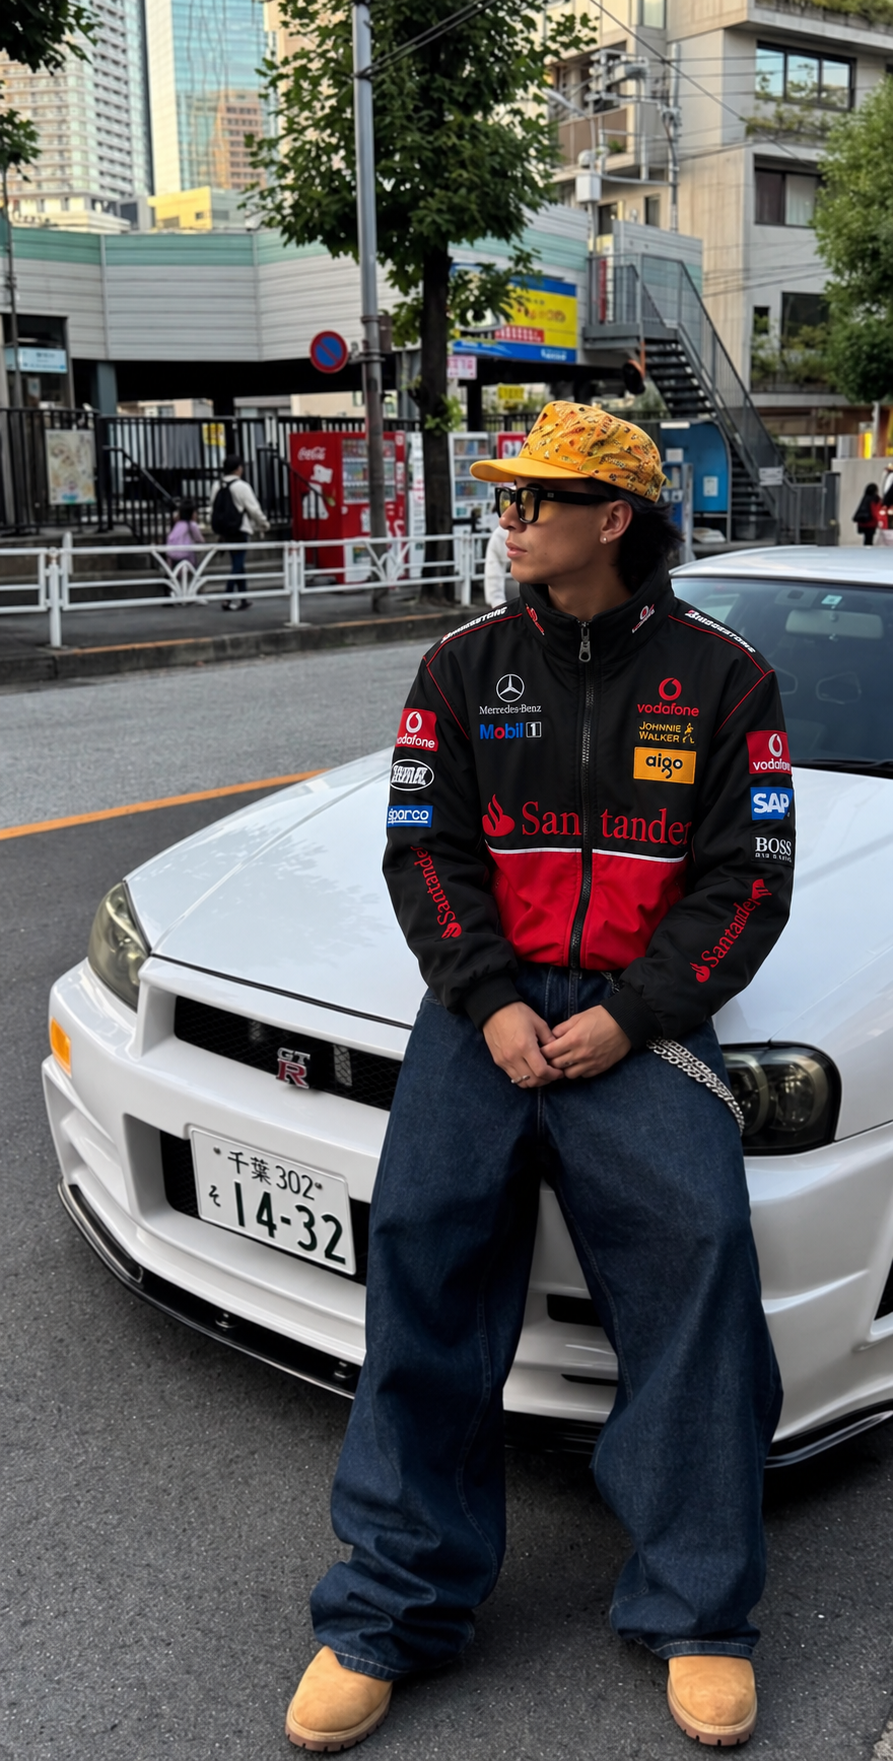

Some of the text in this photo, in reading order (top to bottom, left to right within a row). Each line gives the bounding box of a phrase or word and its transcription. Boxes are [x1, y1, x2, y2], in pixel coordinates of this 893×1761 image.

[479, 703, 542, 716] Mercedes-Benz
[637, 702, 700, 717] vodafone
[479, 722, 525, 740] Mobil
[639, 720, 682, 733] JOHNNIE
[396, 732, 436, 749] odafone
[639, 731, 680, 743] WALKER
[645, 752, 684, 779] aigo
[752, 792, 790, 814] SAP
[387, 808, 430, 823] sparco
[755, 836, 792, 857] BOSS
[410, 846, 456, 926] Santander
[277, 1047, 311, 1066] GT
[275, 1058, 310, 1089] R
[228, 1150, 316, 1202] 千葉 302
[208, 1180, 347, 1266] そ 14-32
